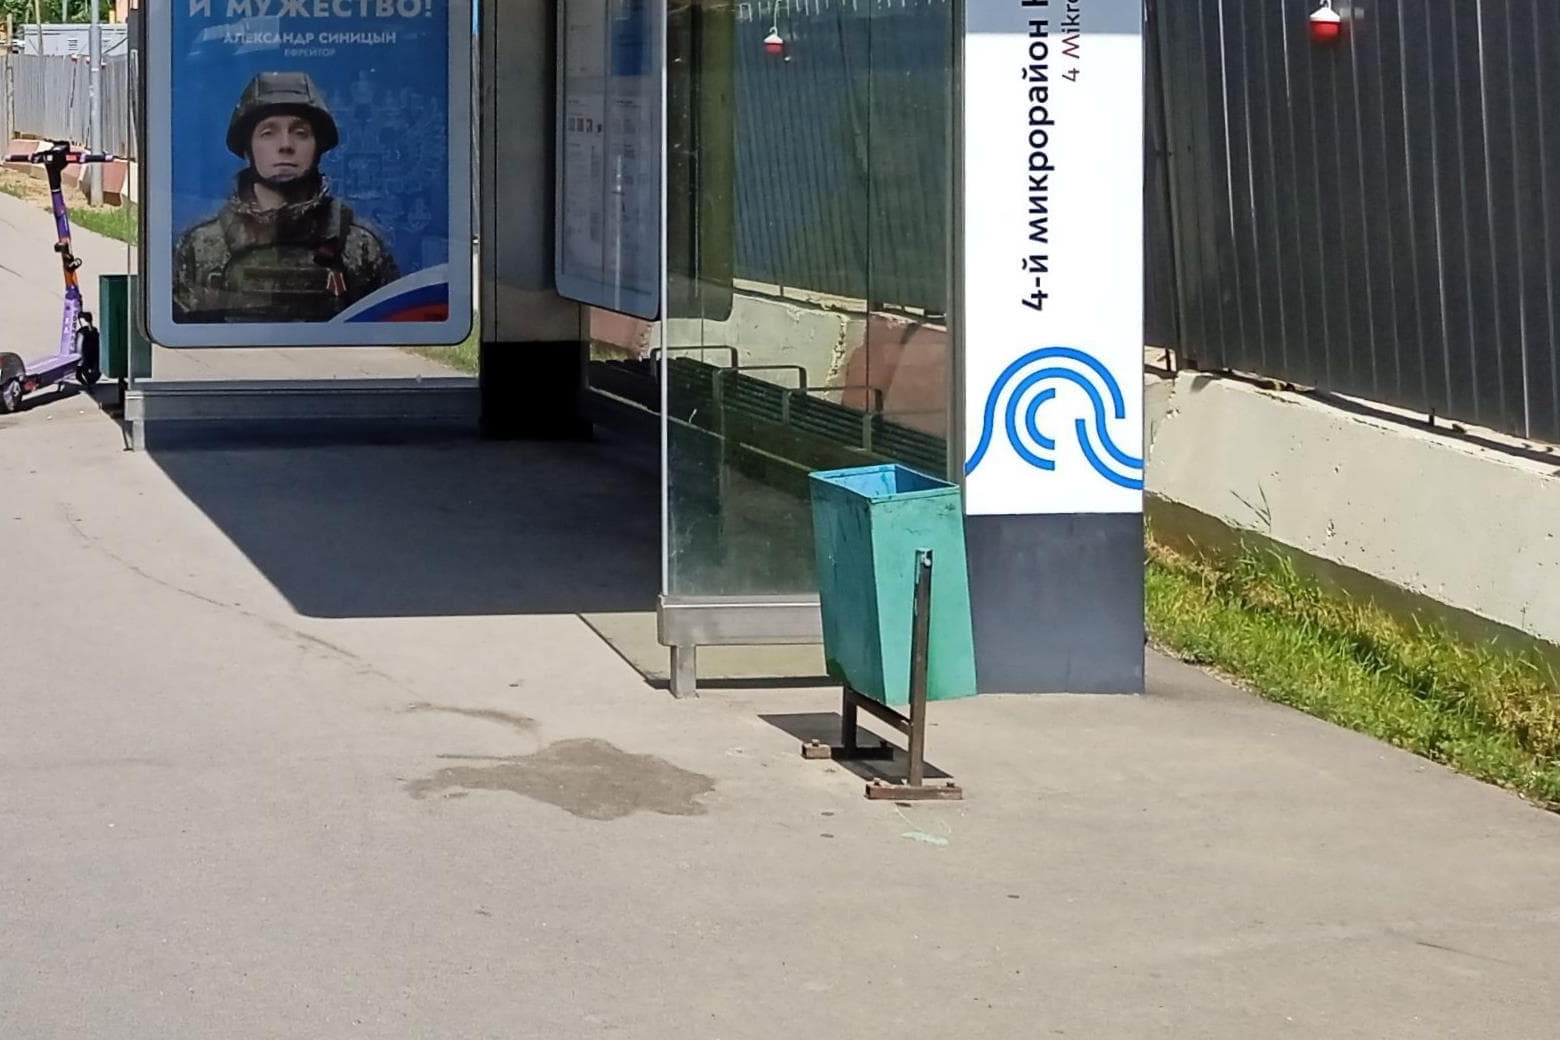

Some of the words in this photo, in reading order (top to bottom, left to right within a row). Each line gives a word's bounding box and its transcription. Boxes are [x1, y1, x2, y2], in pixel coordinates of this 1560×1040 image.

[223, 32, 315, 44] АЛЕКСАНДР
[318, 32, 397, 45] СИНИЦЫН
[1061, 67, 1080, 82] 4
[1020, 18, 1055, 244] микрорайон
[1021, 254, 1048, 311] 4-й
